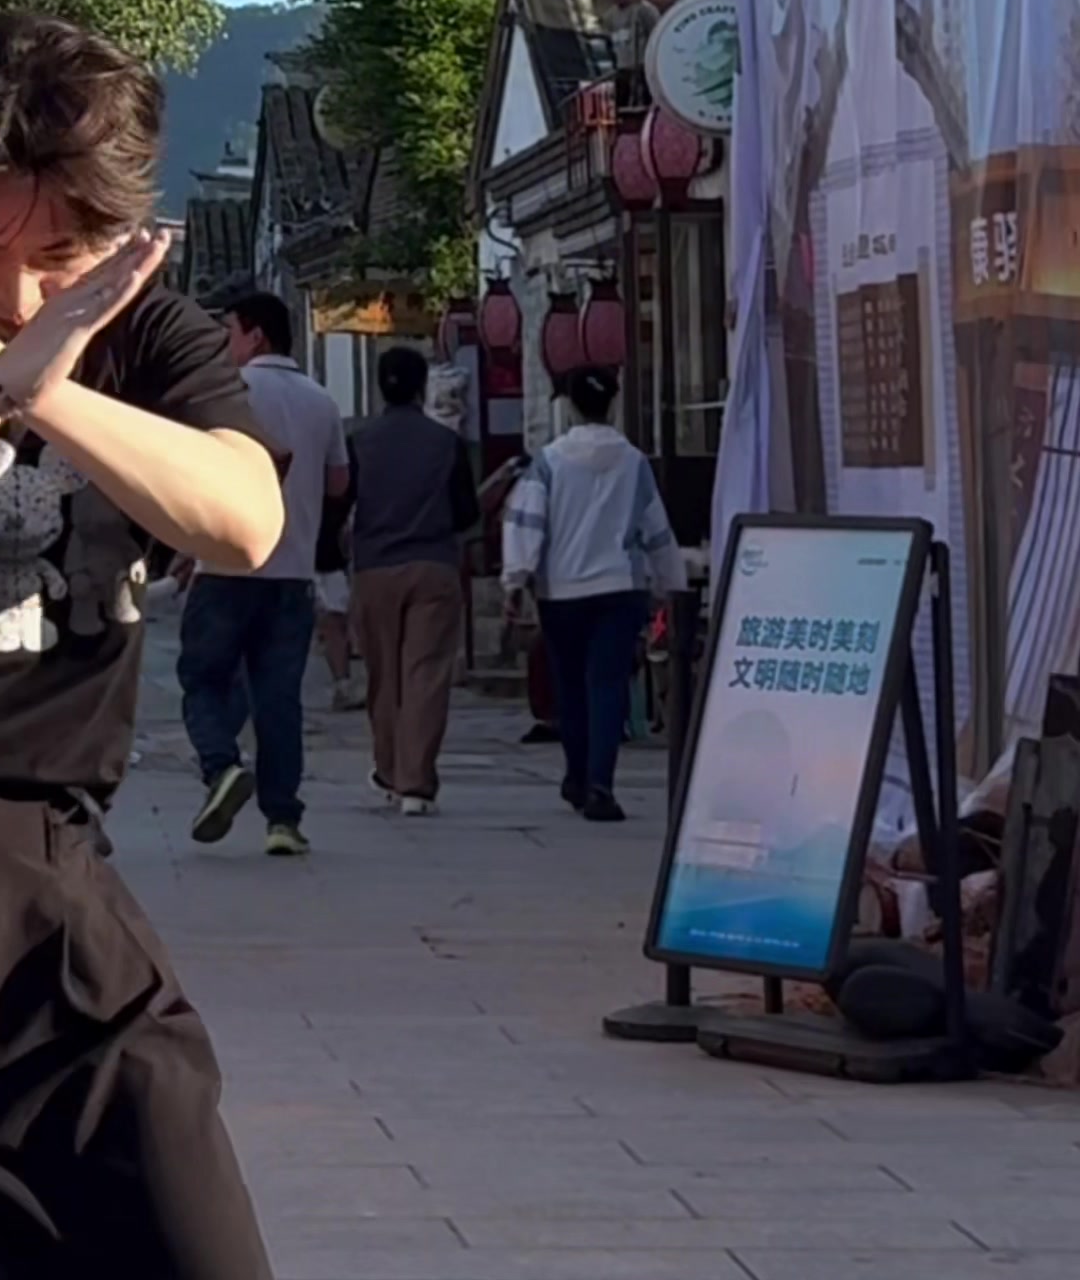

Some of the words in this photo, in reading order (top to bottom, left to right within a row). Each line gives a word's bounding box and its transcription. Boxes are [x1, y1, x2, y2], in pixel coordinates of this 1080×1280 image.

[735, 615, 881, 655] 旅游美时美刻
[728, 656, 872, 696] 文明随时随地
